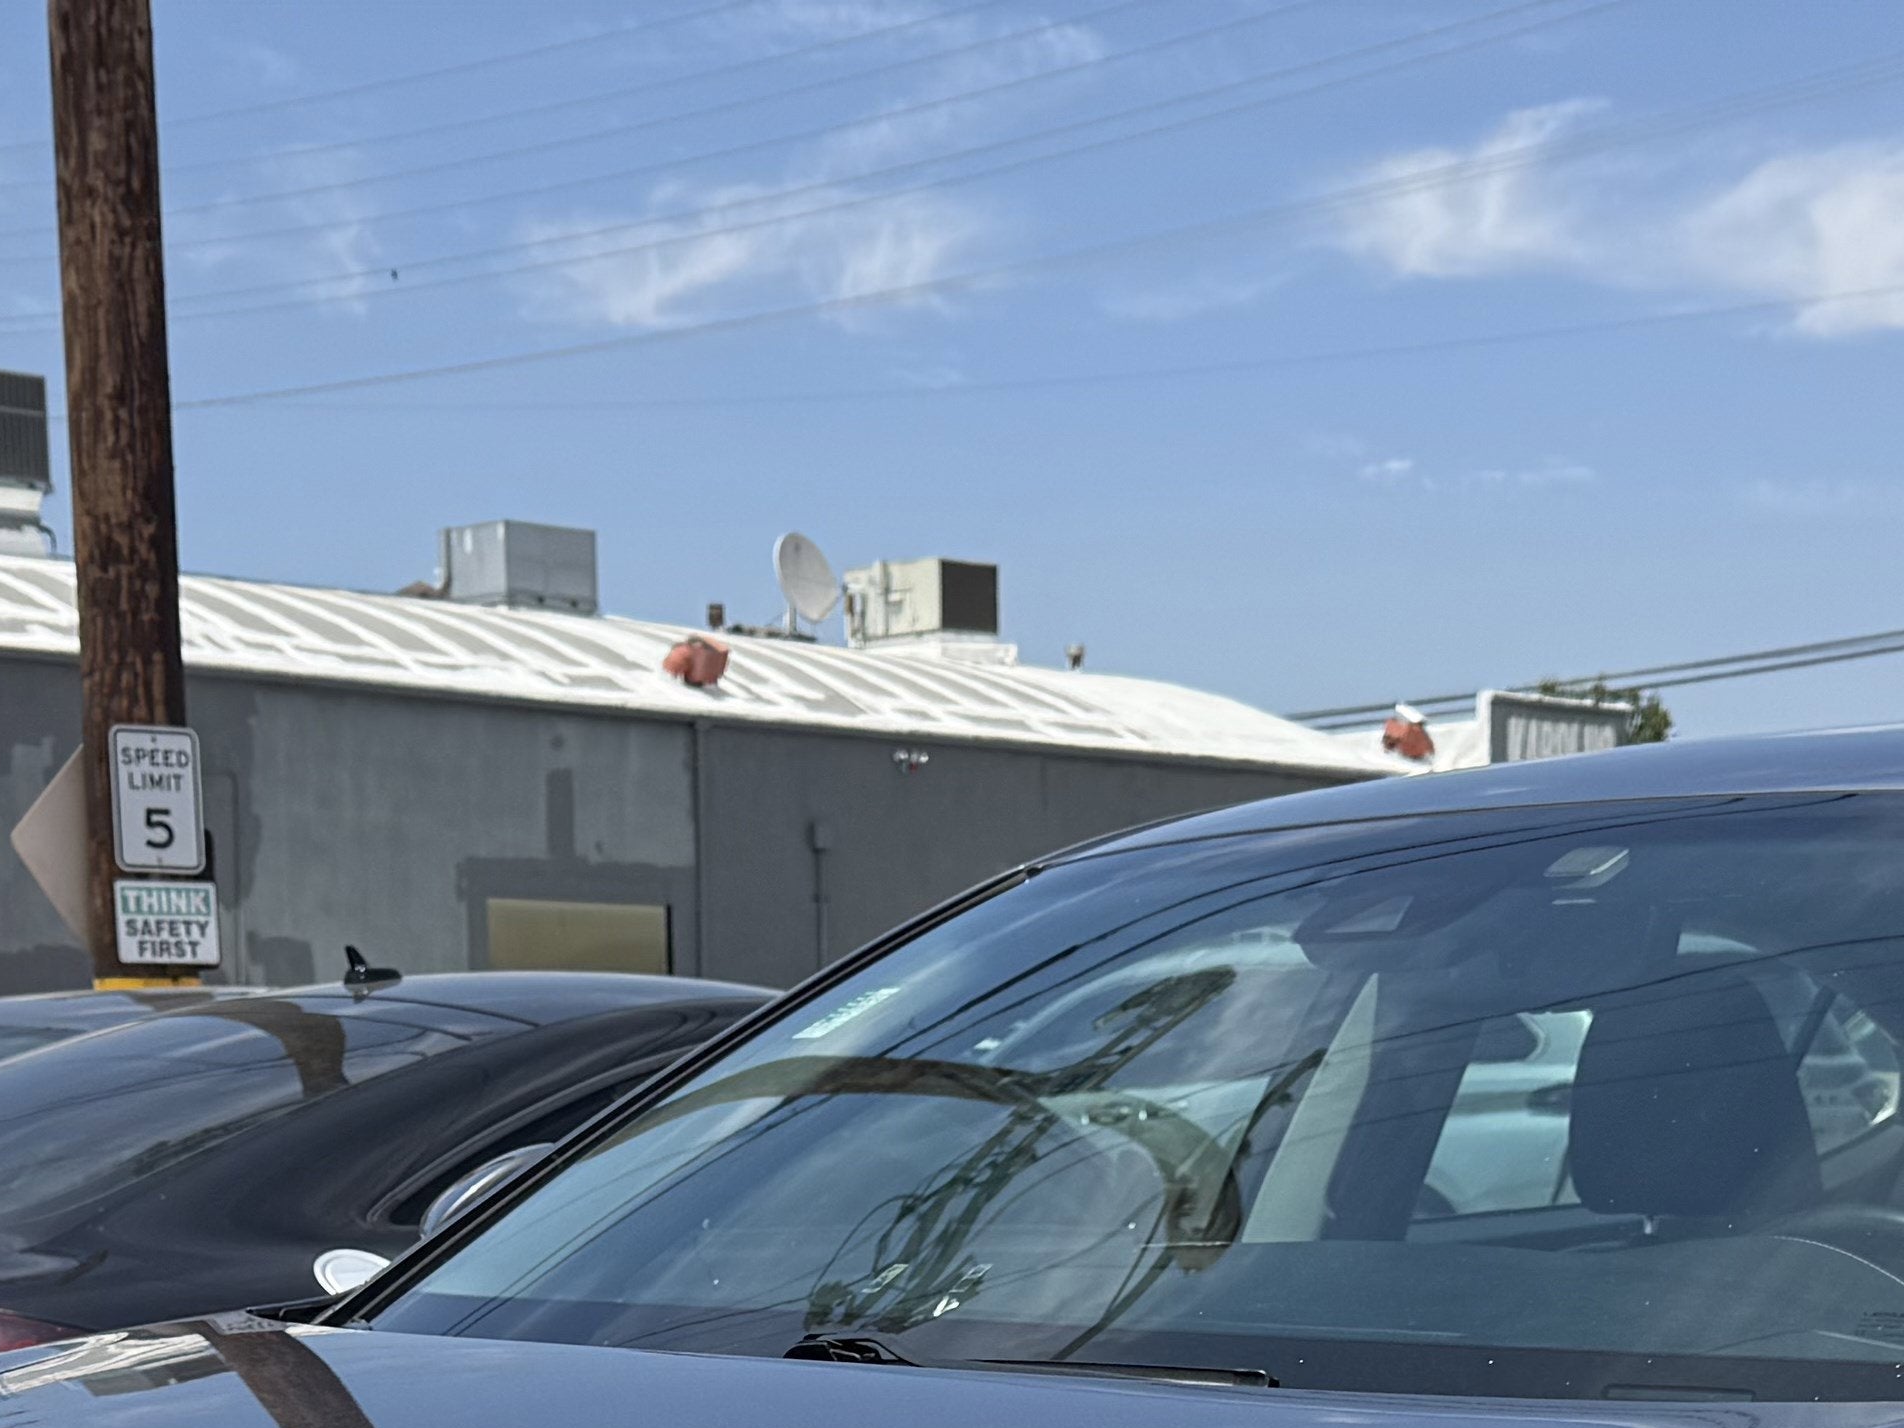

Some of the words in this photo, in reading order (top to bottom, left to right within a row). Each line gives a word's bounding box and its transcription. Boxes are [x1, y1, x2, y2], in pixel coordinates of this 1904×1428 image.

[120, 746, 191, 768] SPEED
[128, 773, 185, 792] LIMIT
[145, 807, 176, 850] 5
[123, 888, 209, 914] THINK
[125, 918, 210, 939] SAFETY
[137, 940, 202, 960] FIRST
